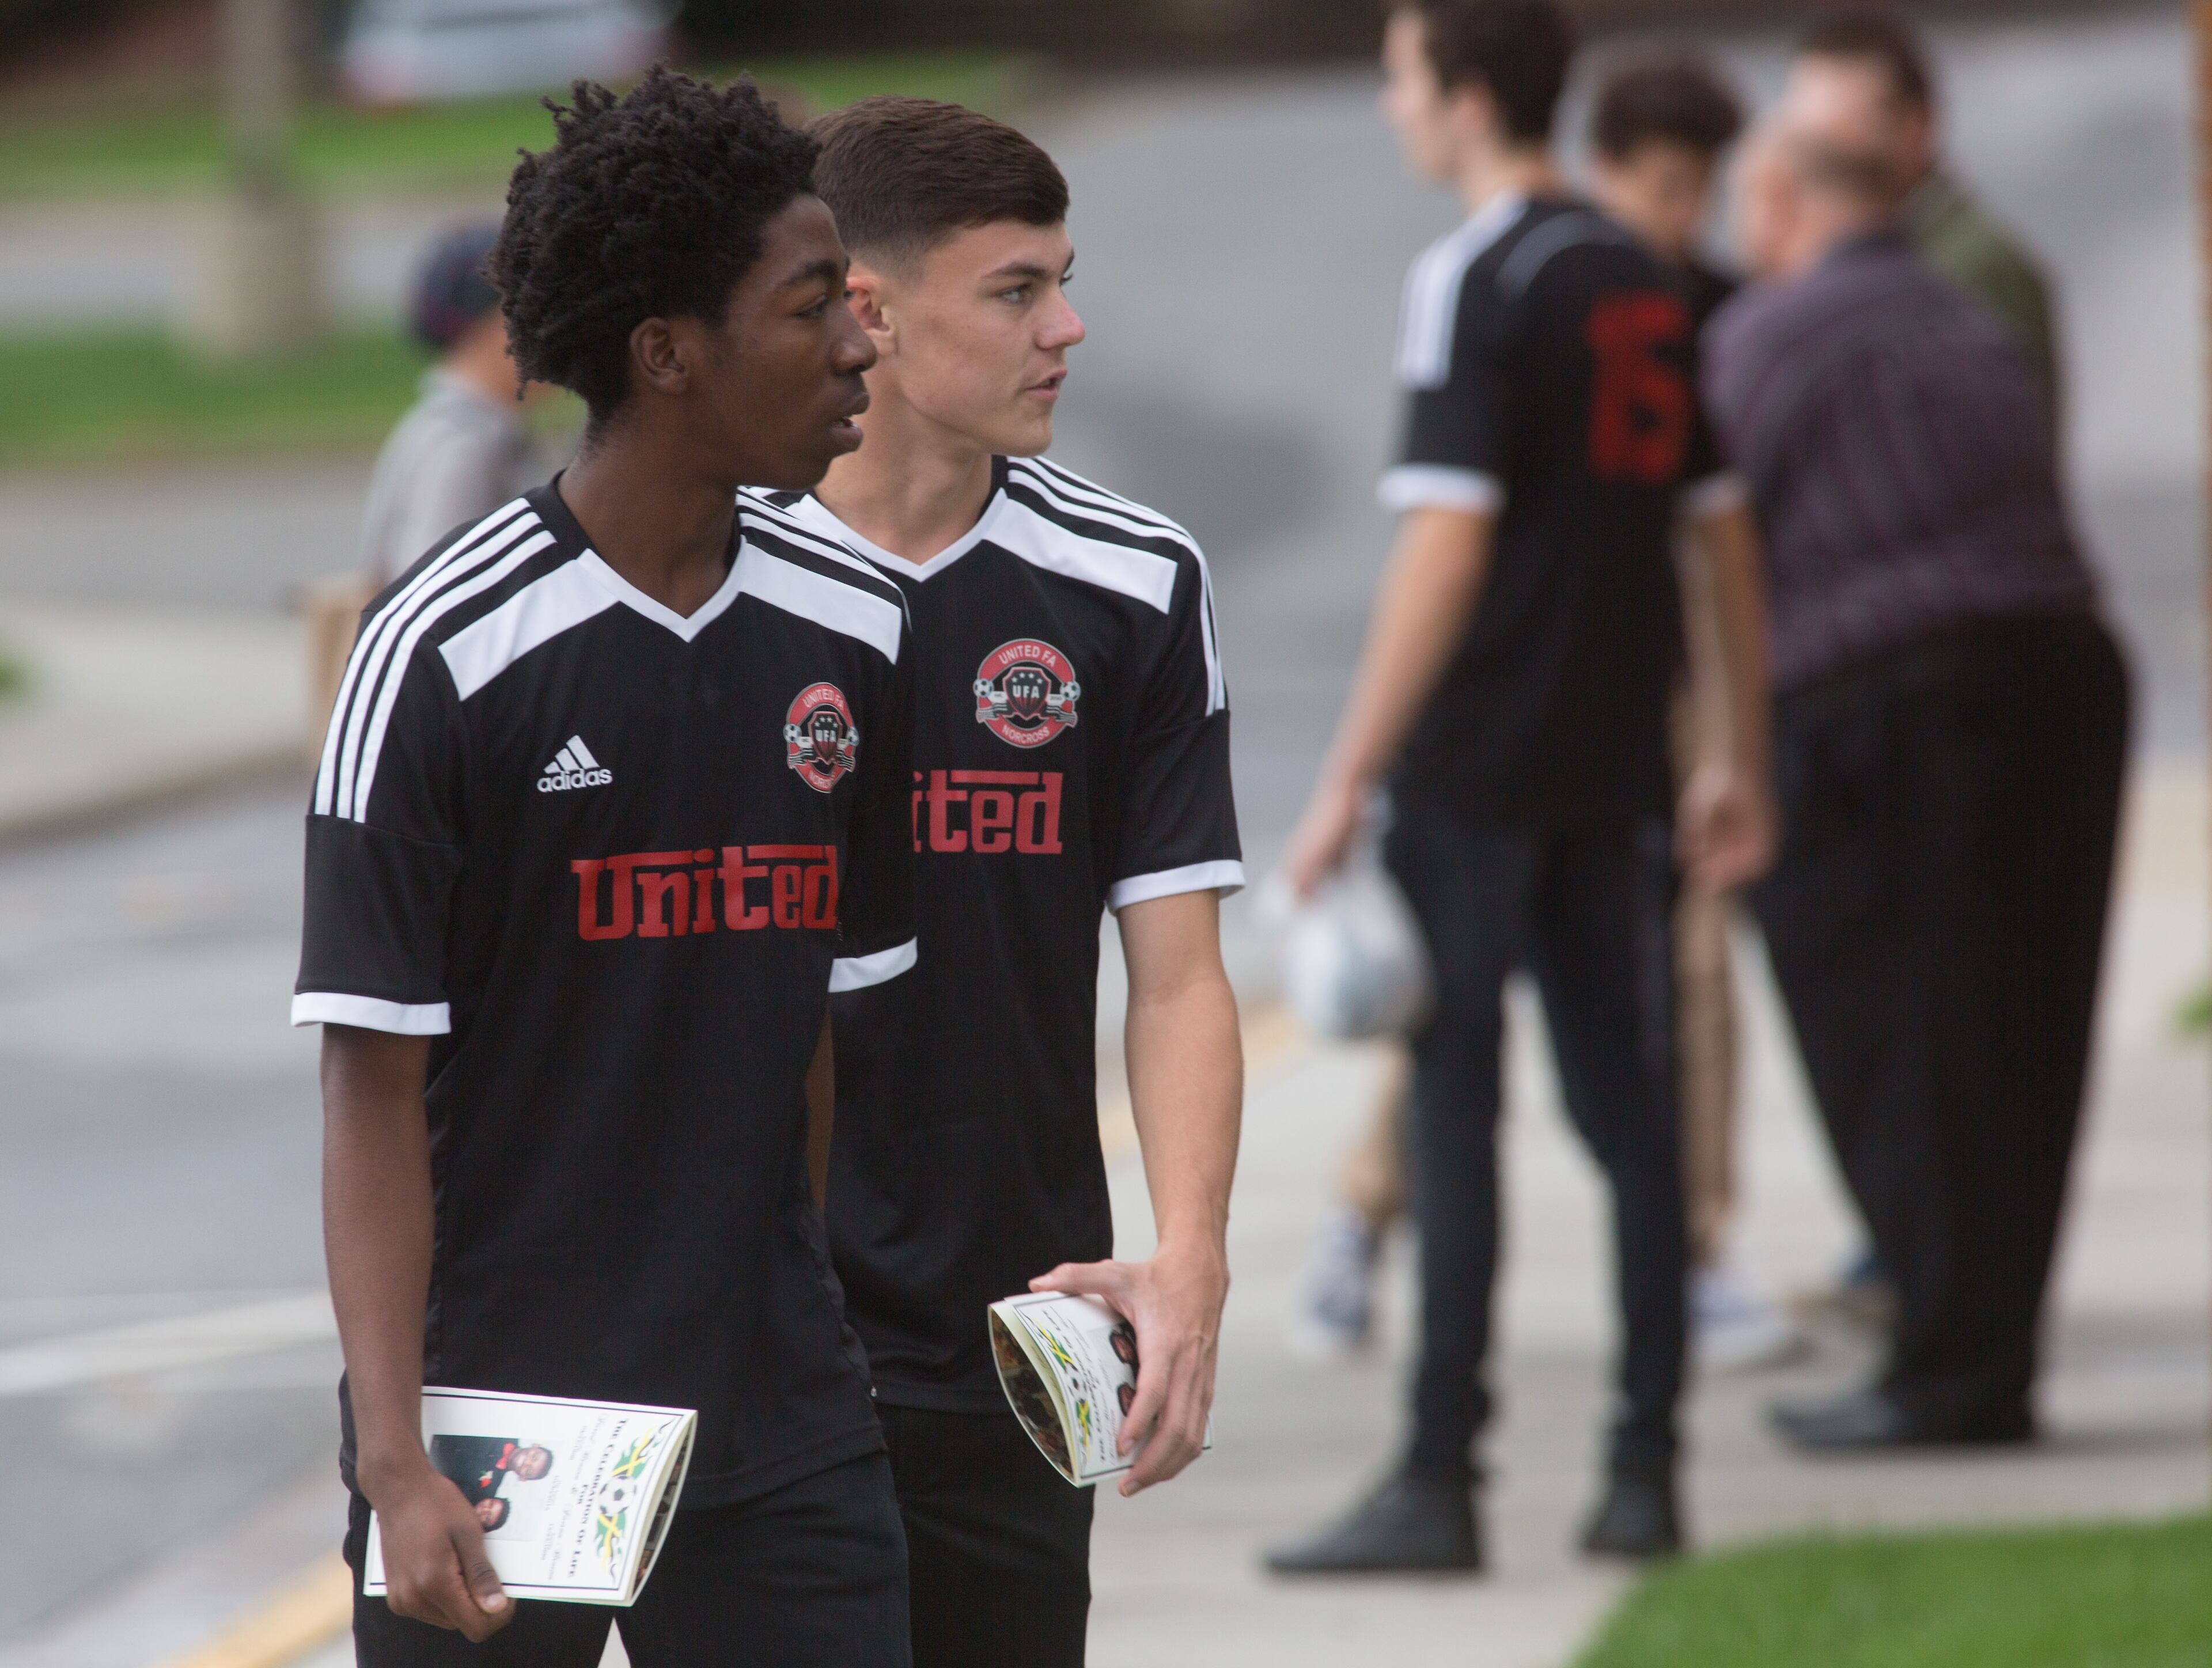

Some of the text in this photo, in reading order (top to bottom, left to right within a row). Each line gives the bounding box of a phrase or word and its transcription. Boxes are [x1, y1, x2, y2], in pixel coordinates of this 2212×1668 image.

[998, 645, 1056, 668] UNITED FA
[802, 688, 835, 708] UNITED
[1012, 685, 1040, 699] UFA
[815, 729, 836, 742] UFA
[1002, 725, 1050, 744] NORCROSS
[536, 768, 613, 793] adidas
[912, 769, 1063, 855] ited
[571, 844, 839, 941] United
[611, 1418, 629, 1437] THE
